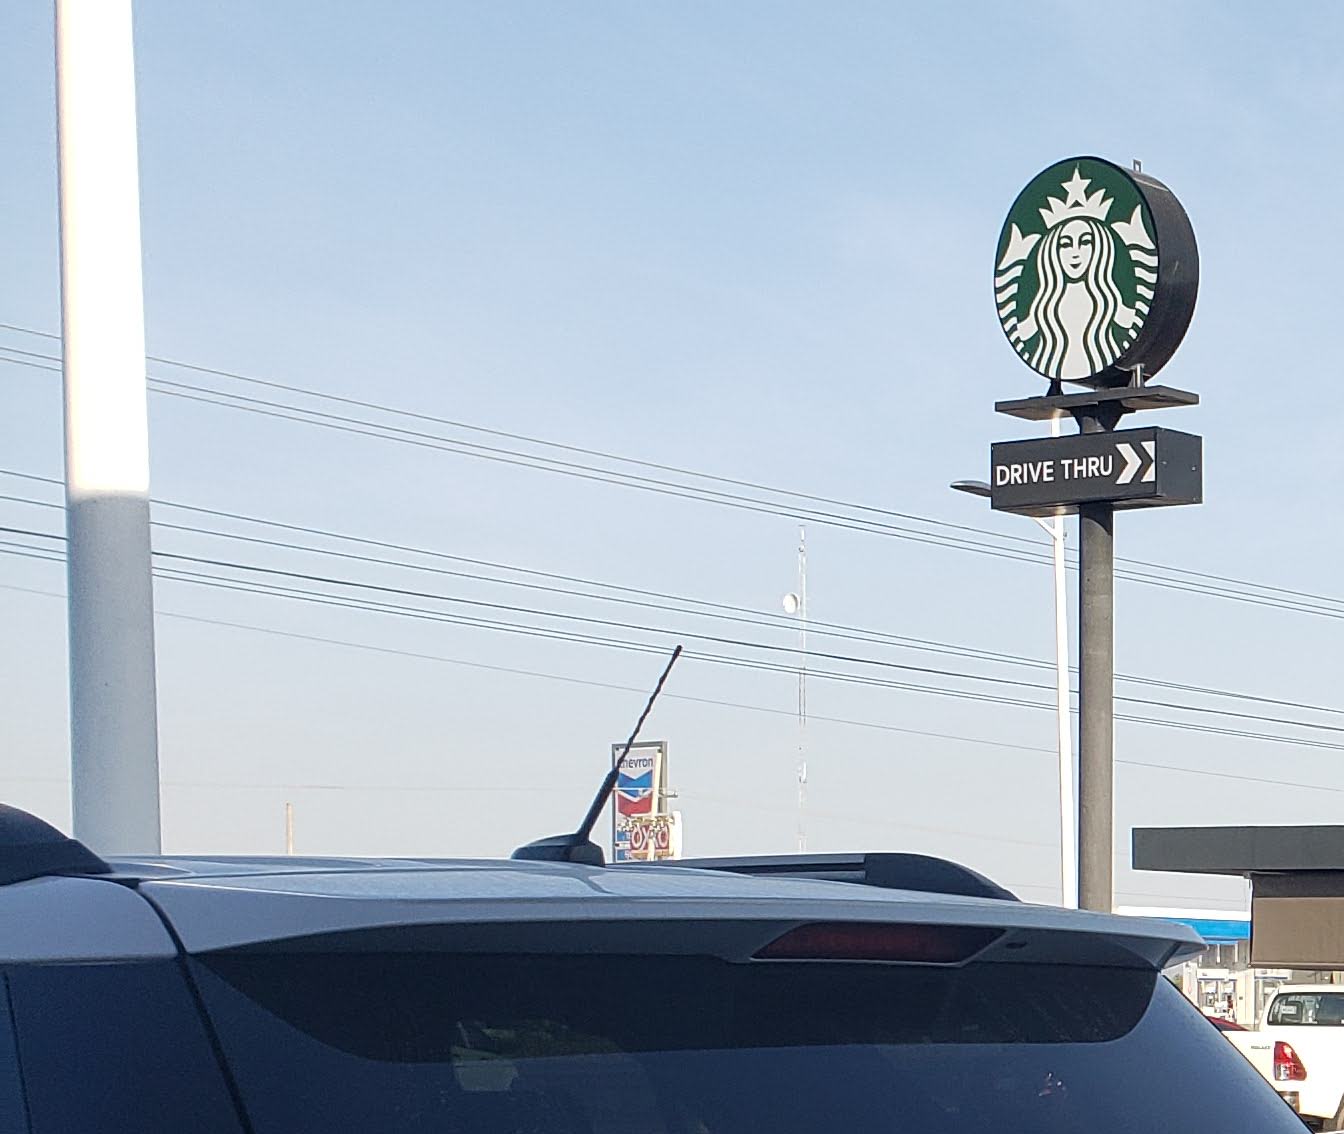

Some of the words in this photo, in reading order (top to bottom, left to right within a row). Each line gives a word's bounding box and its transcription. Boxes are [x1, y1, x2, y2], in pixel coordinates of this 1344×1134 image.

[996, 460, 1054, 486] DRIVE
[1060, 454, 1114, 481] THRU
[619, 758, 654, 769] hevron
